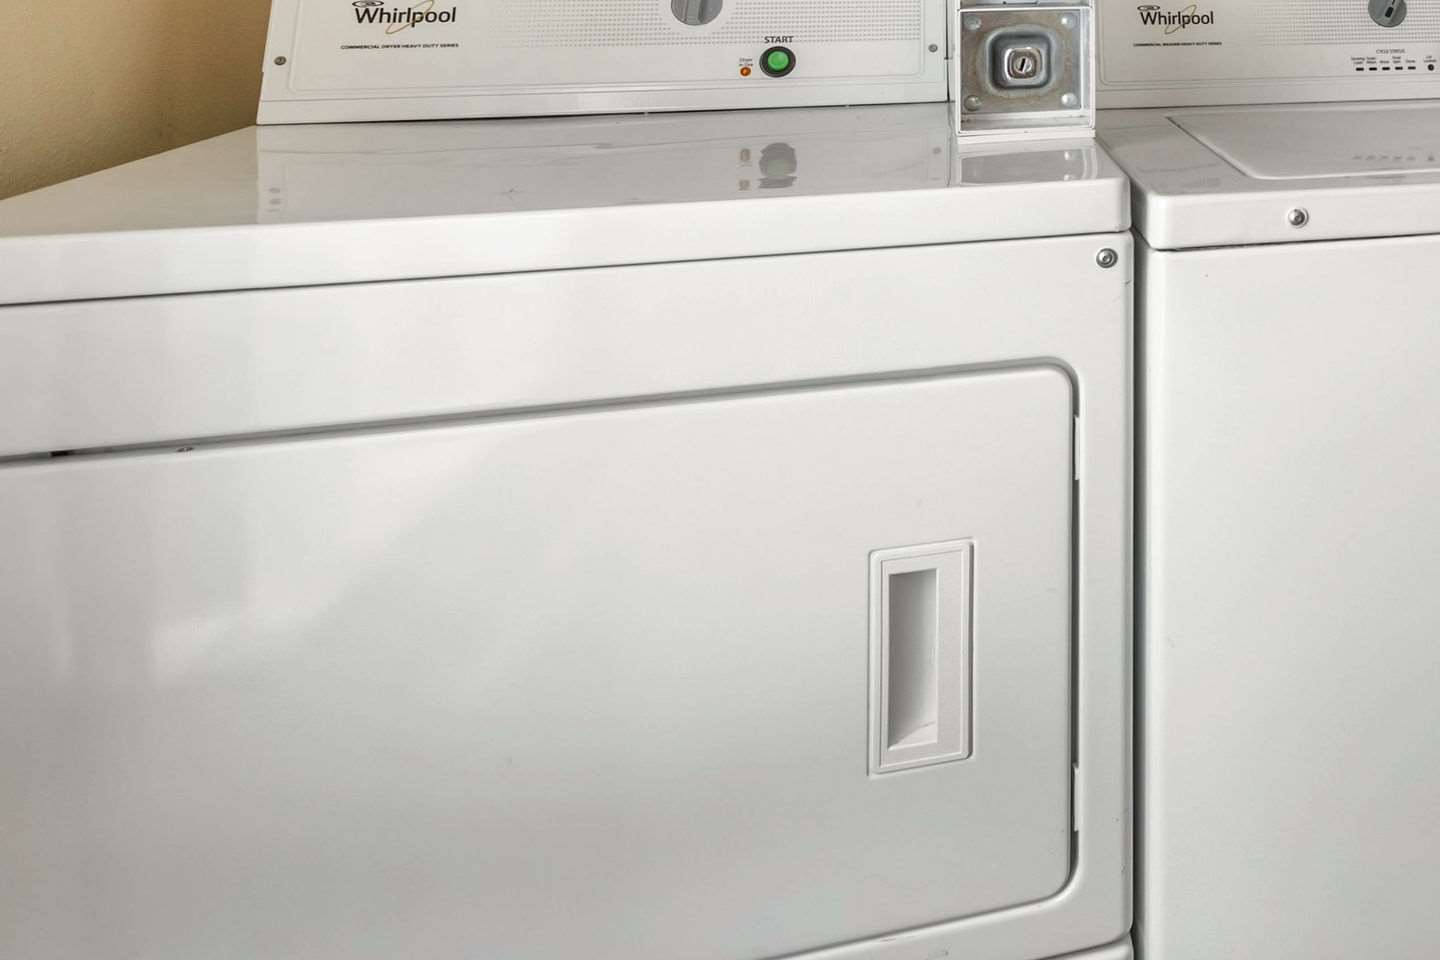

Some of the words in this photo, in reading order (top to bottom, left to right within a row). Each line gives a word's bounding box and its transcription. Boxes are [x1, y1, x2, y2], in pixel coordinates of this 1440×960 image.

[354, 6, 457, 28] Whirlpool
[1139, 10, 1214, 29] Whirlpool
[764, 35, 795, 44] START
